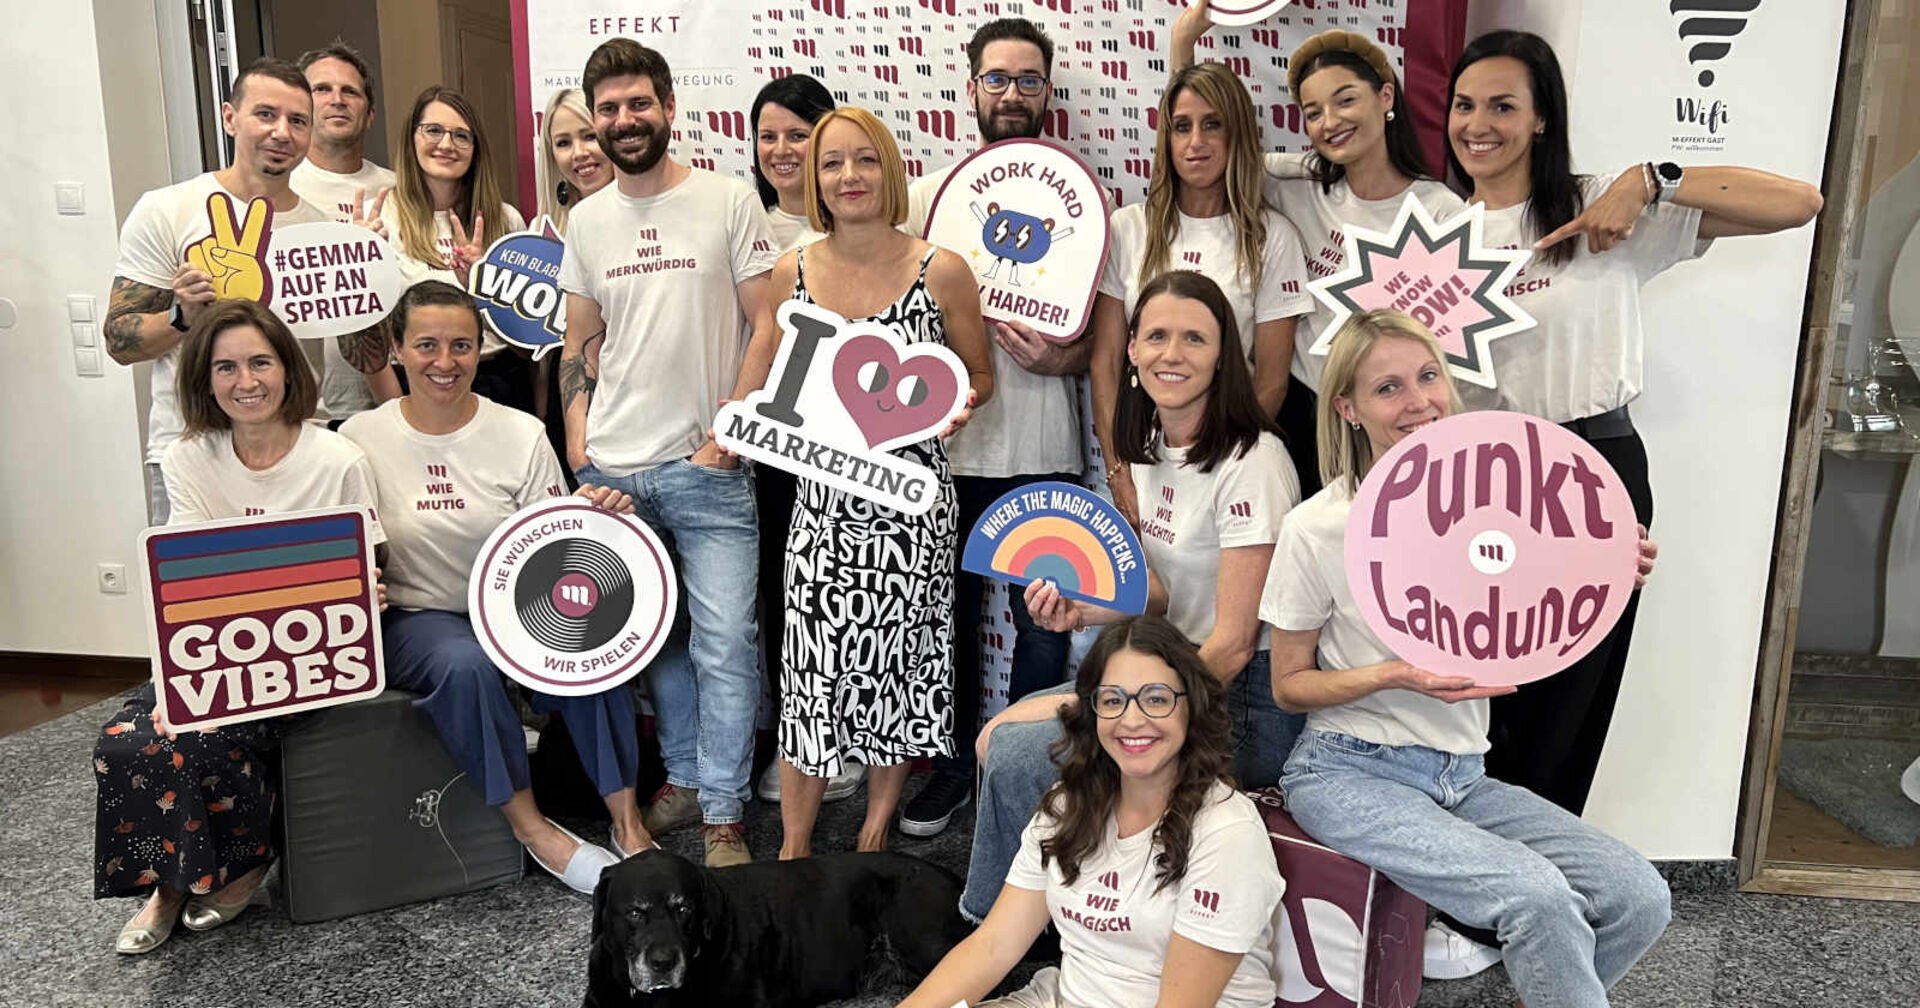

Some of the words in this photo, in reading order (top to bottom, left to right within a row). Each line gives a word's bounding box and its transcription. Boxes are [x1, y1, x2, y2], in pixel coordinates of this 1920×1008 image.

[589, 16, 681, 35] EFFEKT
[545, 77, 583, 87] MARK
[1676, 97, 1730, 134] Wifi
[970, 162, 1035, 195] WORK
[1038, 167, 1083, 218] HARD
[274, 240, 383, 272] #GEMMA
[500, 248, 529, 267] KEIN
[527, 257, 560, 278] BLAB
[637, 245, 662, 258] WIE
[1320, 247, 1344, 265] WIE
[281, 272, 326, 298] AUF
[335, 268, 367, 292] AN
[606, 258, 697, 279] MERKWÜRDIG
[1383, 270, 1411, 295] WE
[284, 292, 384, 324] SPRITZA
[987, 287, 1070, 327] HARDER!
[755, 311, 837, 428] I
[725, 414, 926, 503] MARKETING
[426, 483, 454, 495] WIE
[1371, 421, 1613, 540] Punkt
[416, 498, 466, 511] MUTIG
[980, 498, 1023, 540] WHERE
[1021, 490, 1048, 512] THE
[1051, 491, 1094, 521] MAGIC
[1156, 506, 1173, 522] WIE
[494, 568, 510, 591] SIE
[503, 518, 584, 566] WÜNSCHEN
[820, 583, 905, 628] GOYA
[1370, 561, 1610, 661] Landung
[168, 603, 368, 671] GOOD
[543, 655, 576, 673] WIR
[581, 631, 641, 673] SPIELEN
[840, 621, 905, 676] GOYA
[168, 646, 371, 717] VIBES
[1086, 893, 1120, 911] WIE
[1061, 906, 1132, 932] MAGISCH
